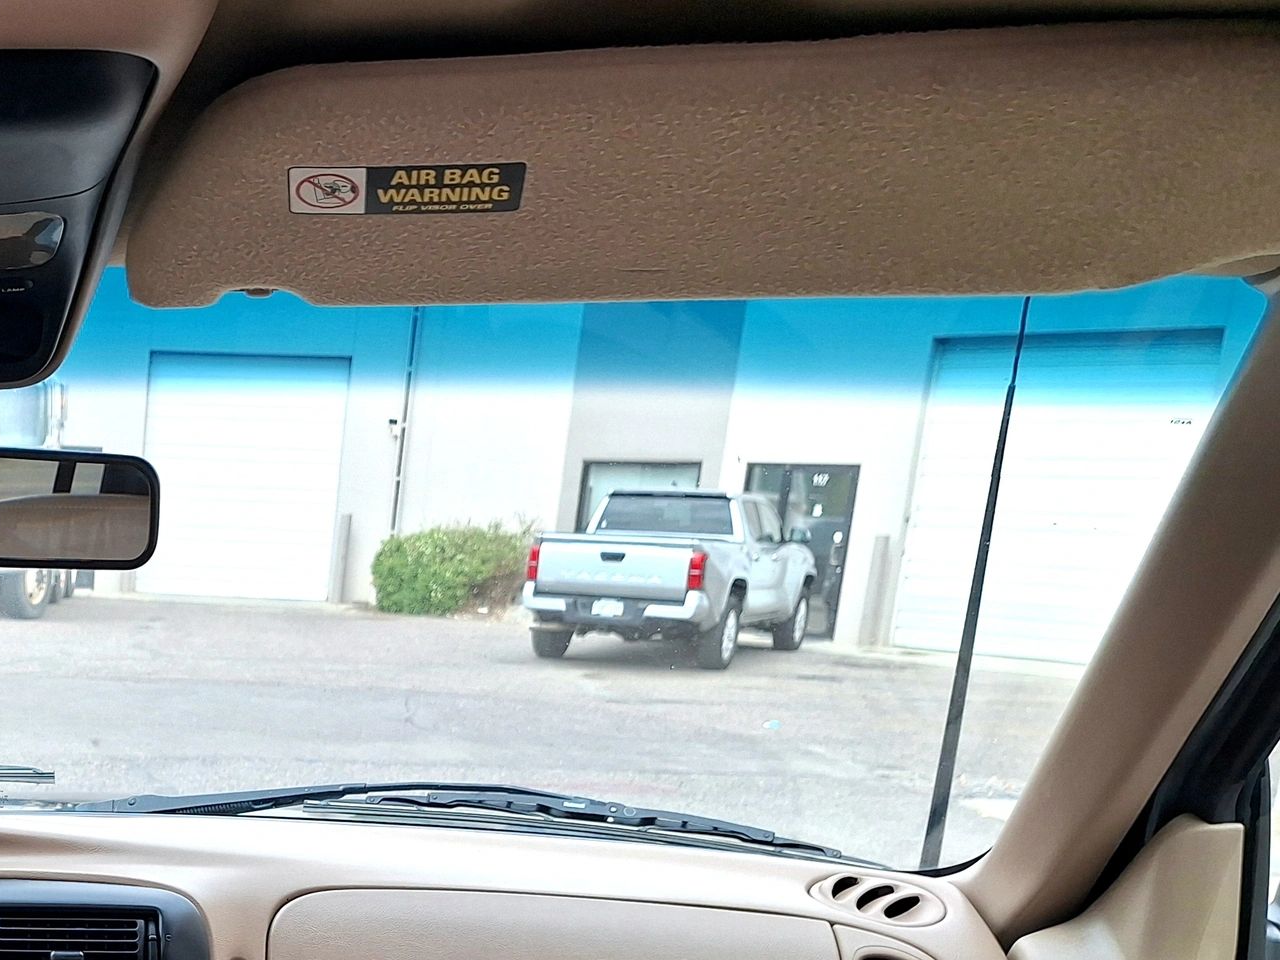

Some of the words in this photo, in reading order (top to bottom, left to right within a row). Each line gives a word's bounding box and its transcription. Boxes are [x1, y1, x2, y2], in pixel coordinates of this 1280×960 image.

[390, 169, 437, 186] AIR
[443, 167, 501, 185] BAG
[377, 185, 510, 204] WARNING
[420, 204, 458, 212] VISOR
[459, 203, 493, 211] OVER
